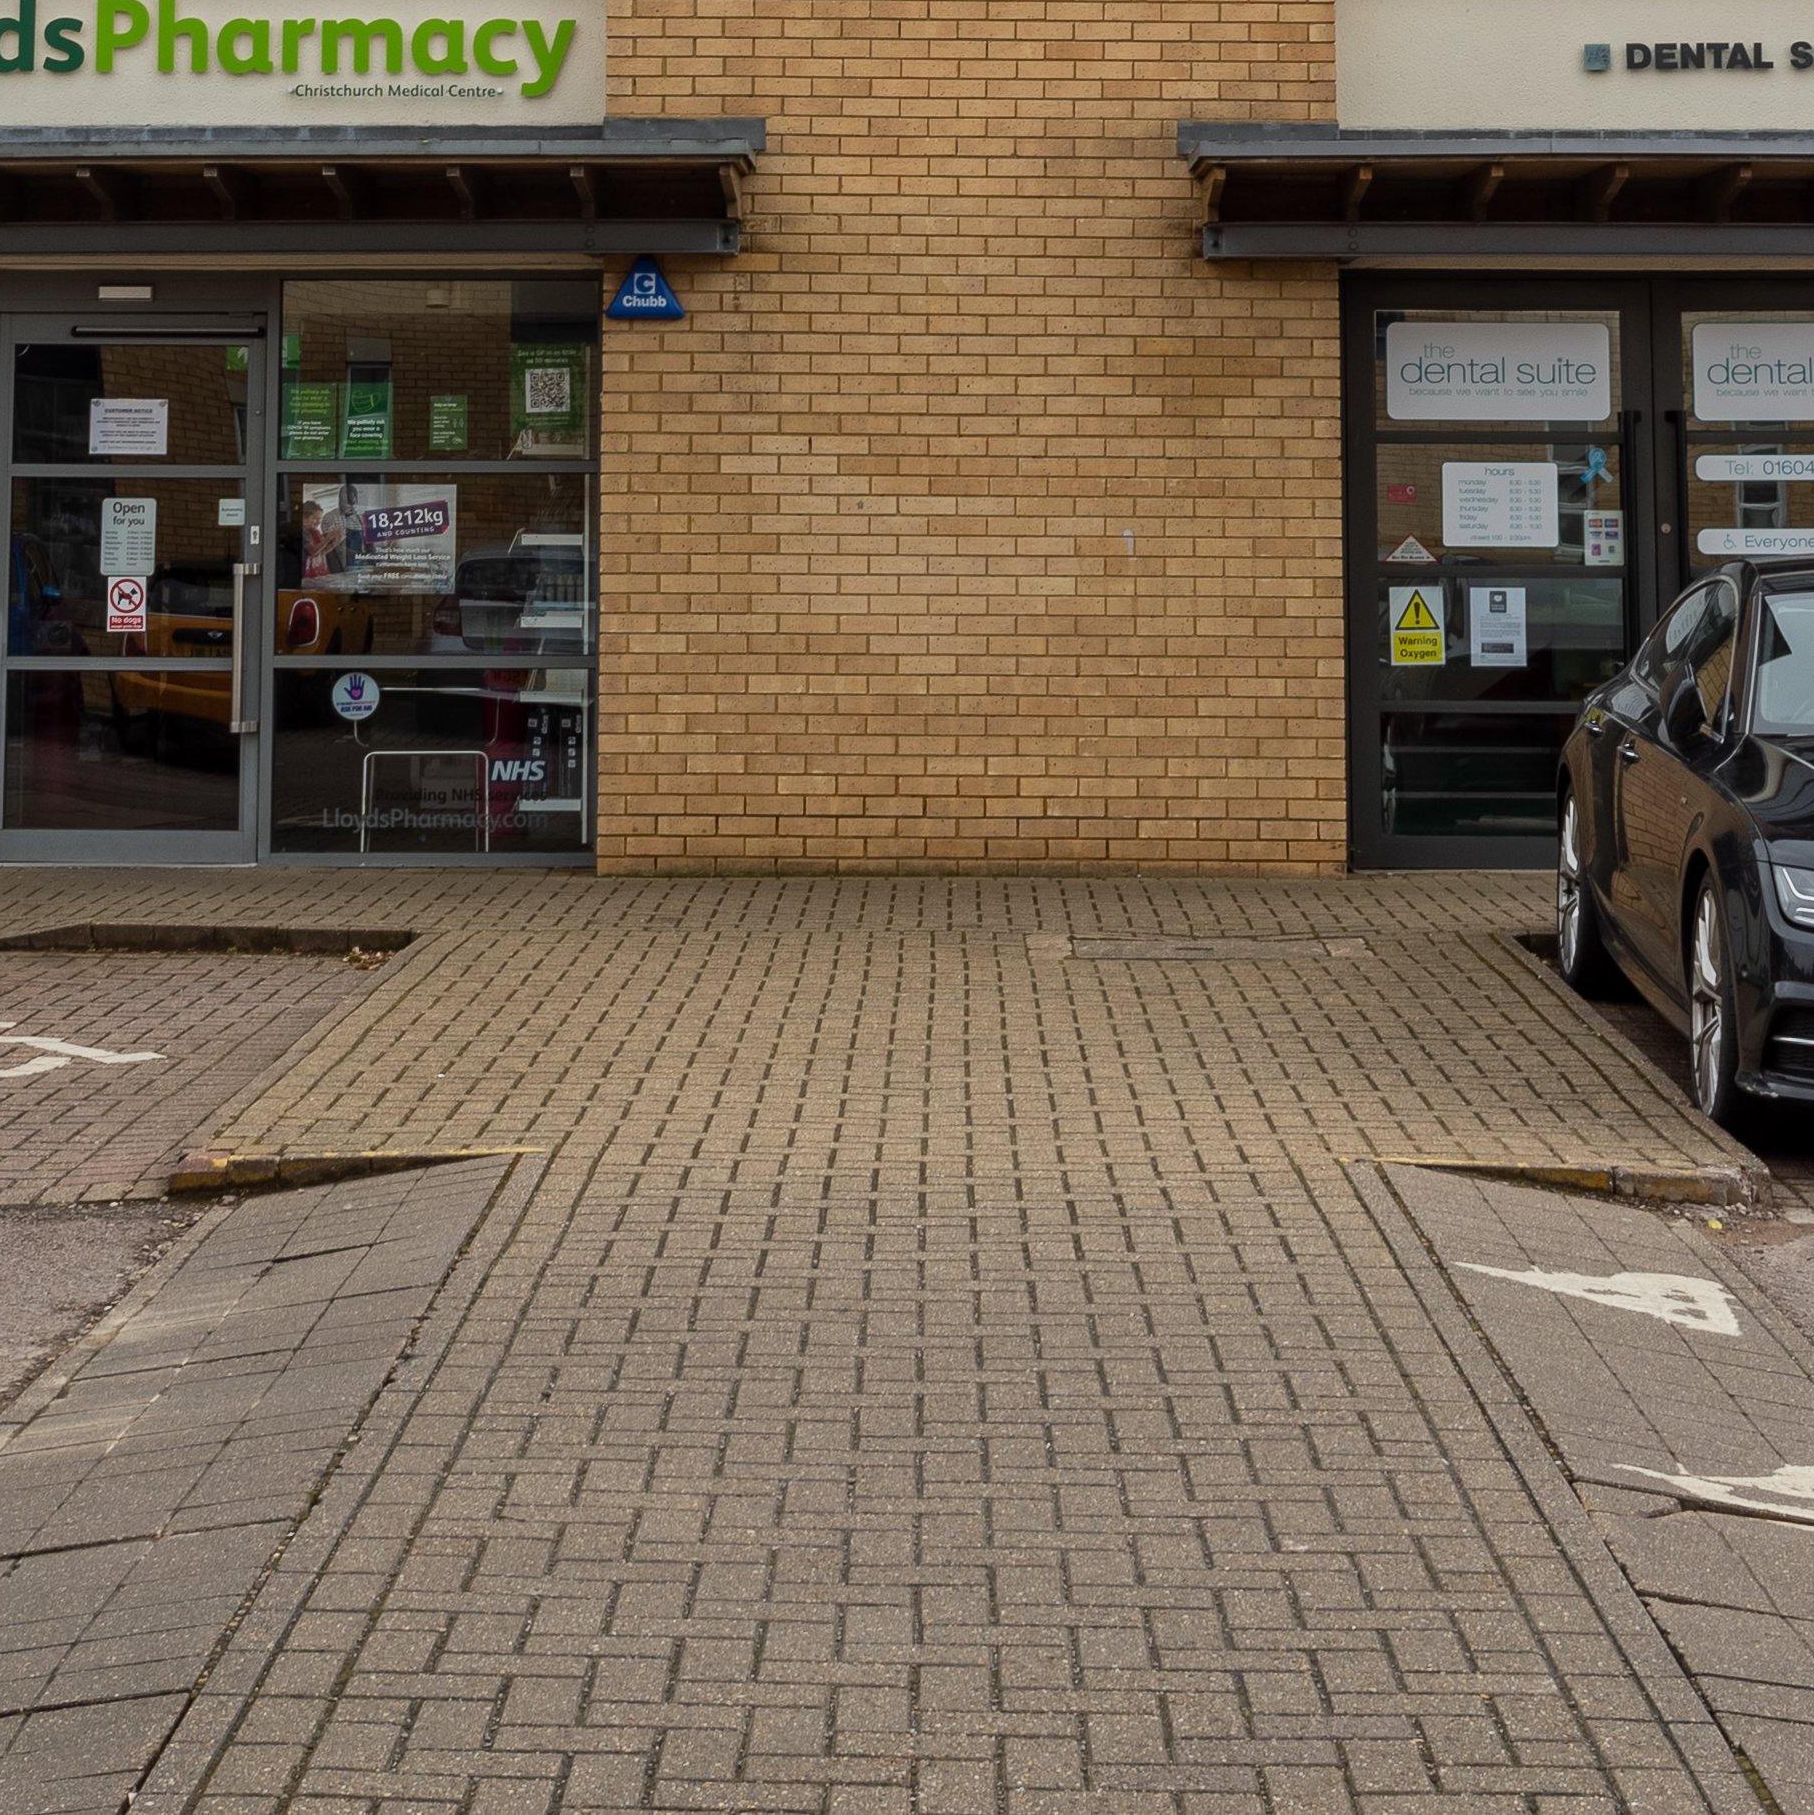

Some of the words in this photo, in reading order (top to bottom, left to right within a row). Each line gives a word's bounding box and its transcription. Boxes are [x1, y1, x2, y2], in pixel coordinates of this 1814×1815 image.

[1625, 41, 1773, 70] DENTAL
[294, 83, 383, 97] Christchurch
[387, 83, 444, 97] Medical
[448, 83, 496, 97] Centre
[621, 292, 666, 308] Chubb
[1423, 341, 1454, 358] the
[1730, 342, 1761, 358] the
[1400, 355, 1505, 383] dental
[1516, 356, 1596, 384] suite
[1707, 356, 1812, 384] dental
[1408, 386, 1452, 395] because
[1475, 387, 1499, 395] want
[1503, 387, 1513, 395] to
[1539, 388, 1557, 397] you
[1561, 386, 1588, 395] smile
[1715, 386, 1759, 396] because
[1763, 388, 1778, 396] we
[1782, 387, 1808, 396] want
[1484, 466, 1514, 475] hours
[1725, 459, 1753, 474] Tel:
[1762, 459, 1814, 474] 01604
[112, 500, 145, 515] Open
[112, 515, 125, 524] for
[127, 517, 145, 526] you
[368, 507, 443, 529] 18,212kg
[376, 529, 392, 537] AND
[394, 525, 434, 535] COUNTING
[389, 552, 412, 561] Weight
[111, 615, 121, 623] No
[123, 615, 141, 624] dogs
[1398, 635, 1437, 646] Warning
[1400, 648, 1436, 658] Oxygen
[491, 759, 545, 781] NHS
[375, 787, 446, 803] Providing
[451, 788, 481, 801] NHS
[487, 788, 546, 801] services
[322, 807, 547, 833] LloydsPharmacy.com
